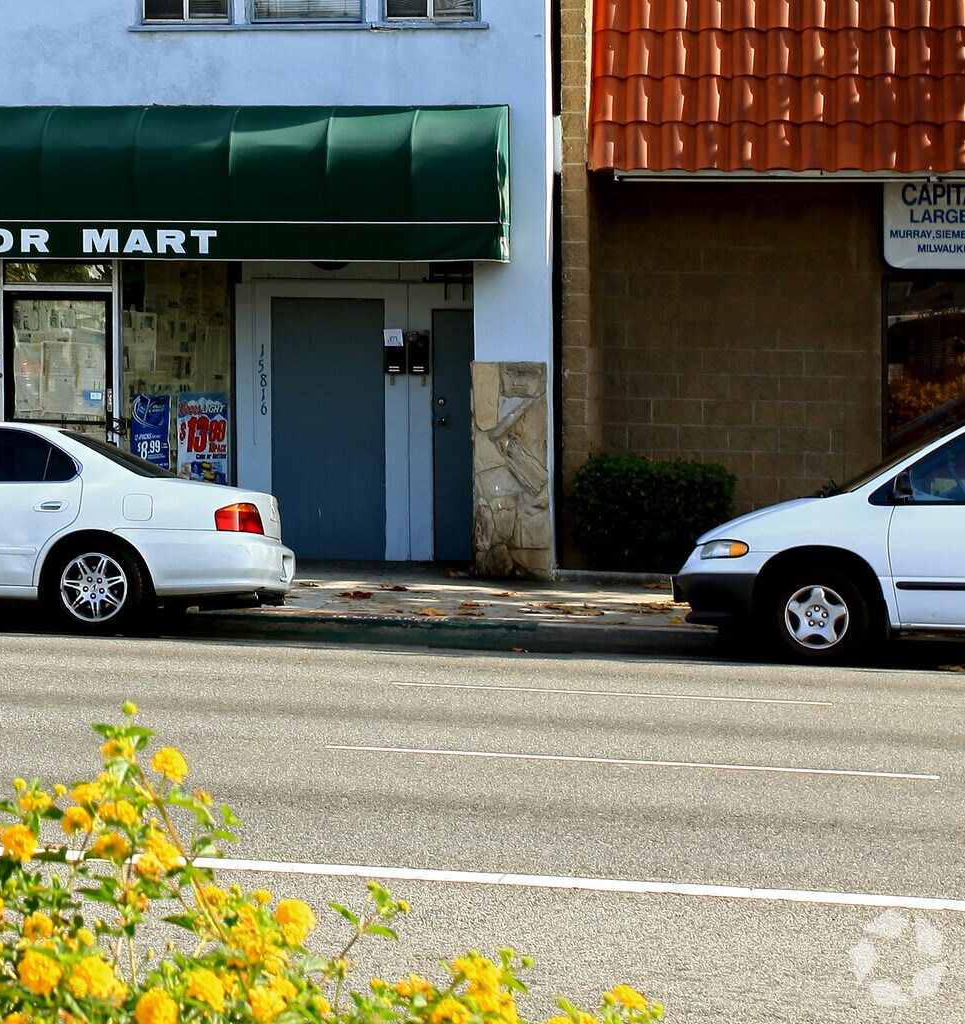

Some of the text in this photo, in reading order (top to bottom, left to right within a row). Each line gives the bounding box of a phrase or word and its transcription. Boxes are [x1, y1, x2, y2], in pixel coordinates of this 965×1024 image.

[901, 183, 965, 206] CAPIT
[82, 229, 218, 254] MART
[257, 343, 268, 416] 15816
